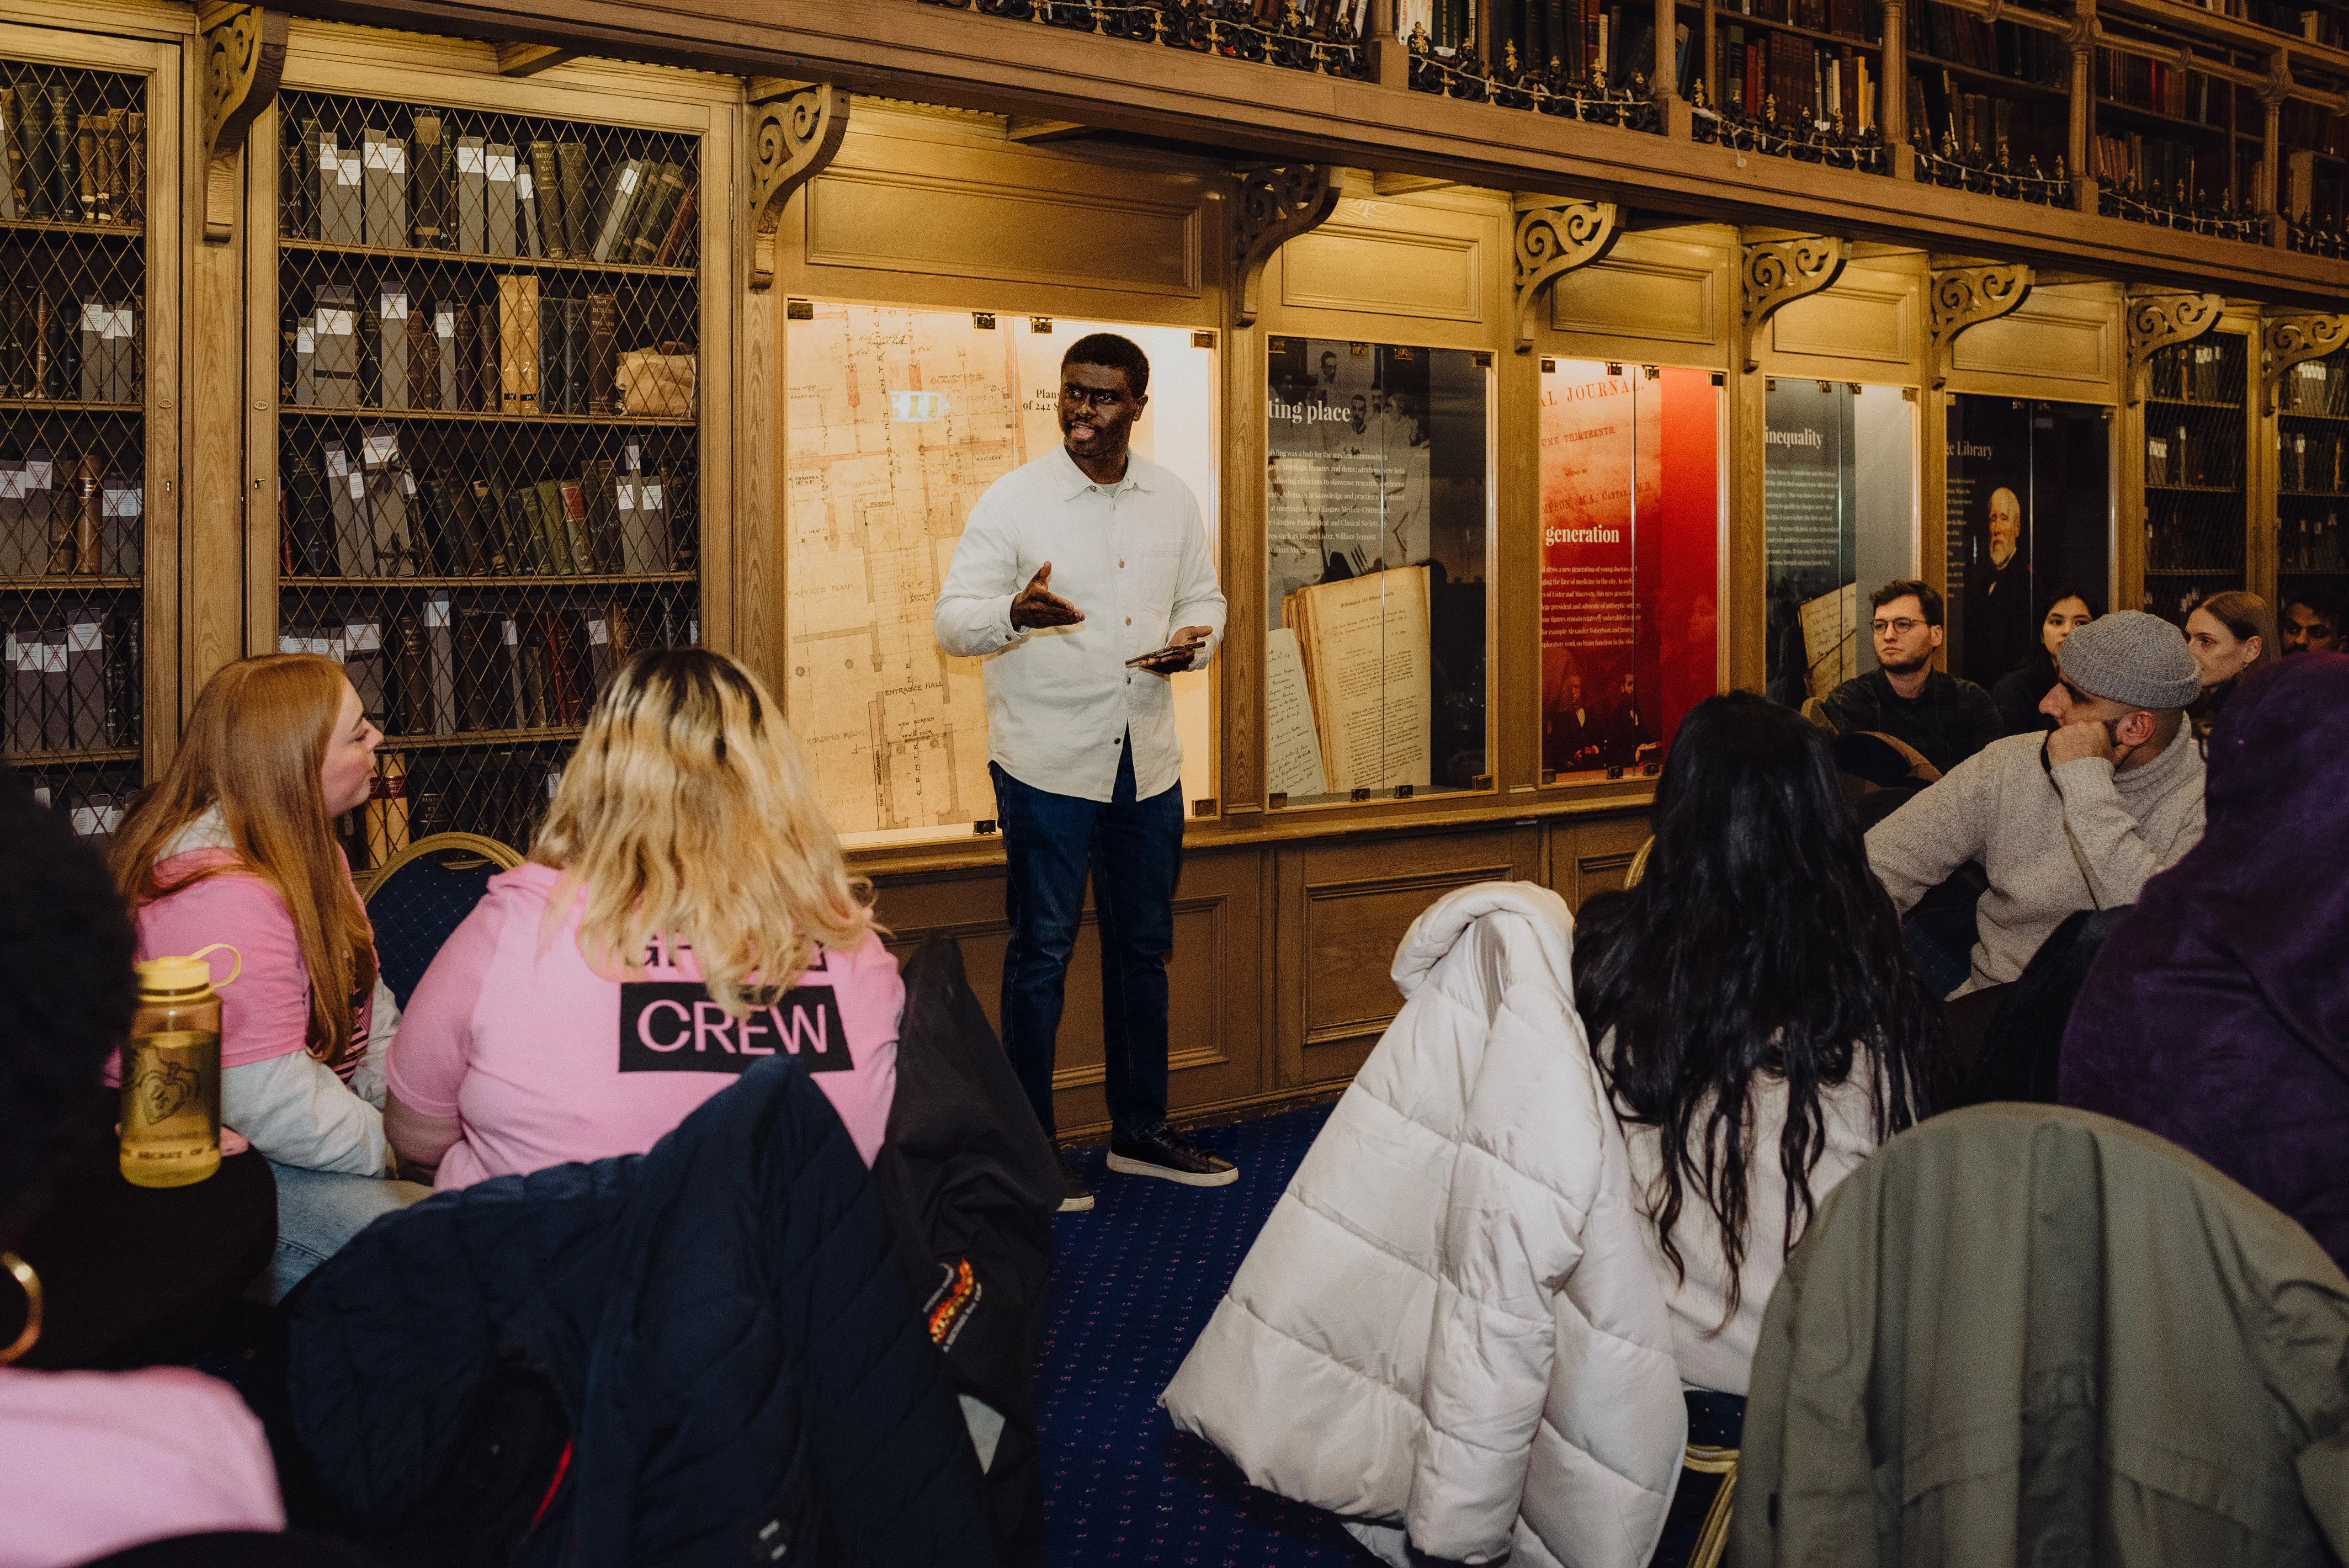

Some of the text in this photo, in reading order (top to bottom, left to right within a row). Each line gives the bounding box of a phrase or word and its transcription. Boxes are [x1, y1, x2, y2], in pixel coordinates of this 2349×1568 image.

[1023, 400, 1033, 410] of
[1035, 403, 1051, 411] 242
[1306, 400, 1351, 424] place
[1765, 426, 1822, 450] inequality
[1323, 450, 1332, 459] the
[1957, 440, 1994, 460] Library
[1545, 524, 1620, 546] generation
[885, 685, 922, 697] ENTRANCE
[913, 716, 935, 725] SCREEN
[843, 729, 865, 740] ROOM
[637, 999, 828, 1055] CREW
